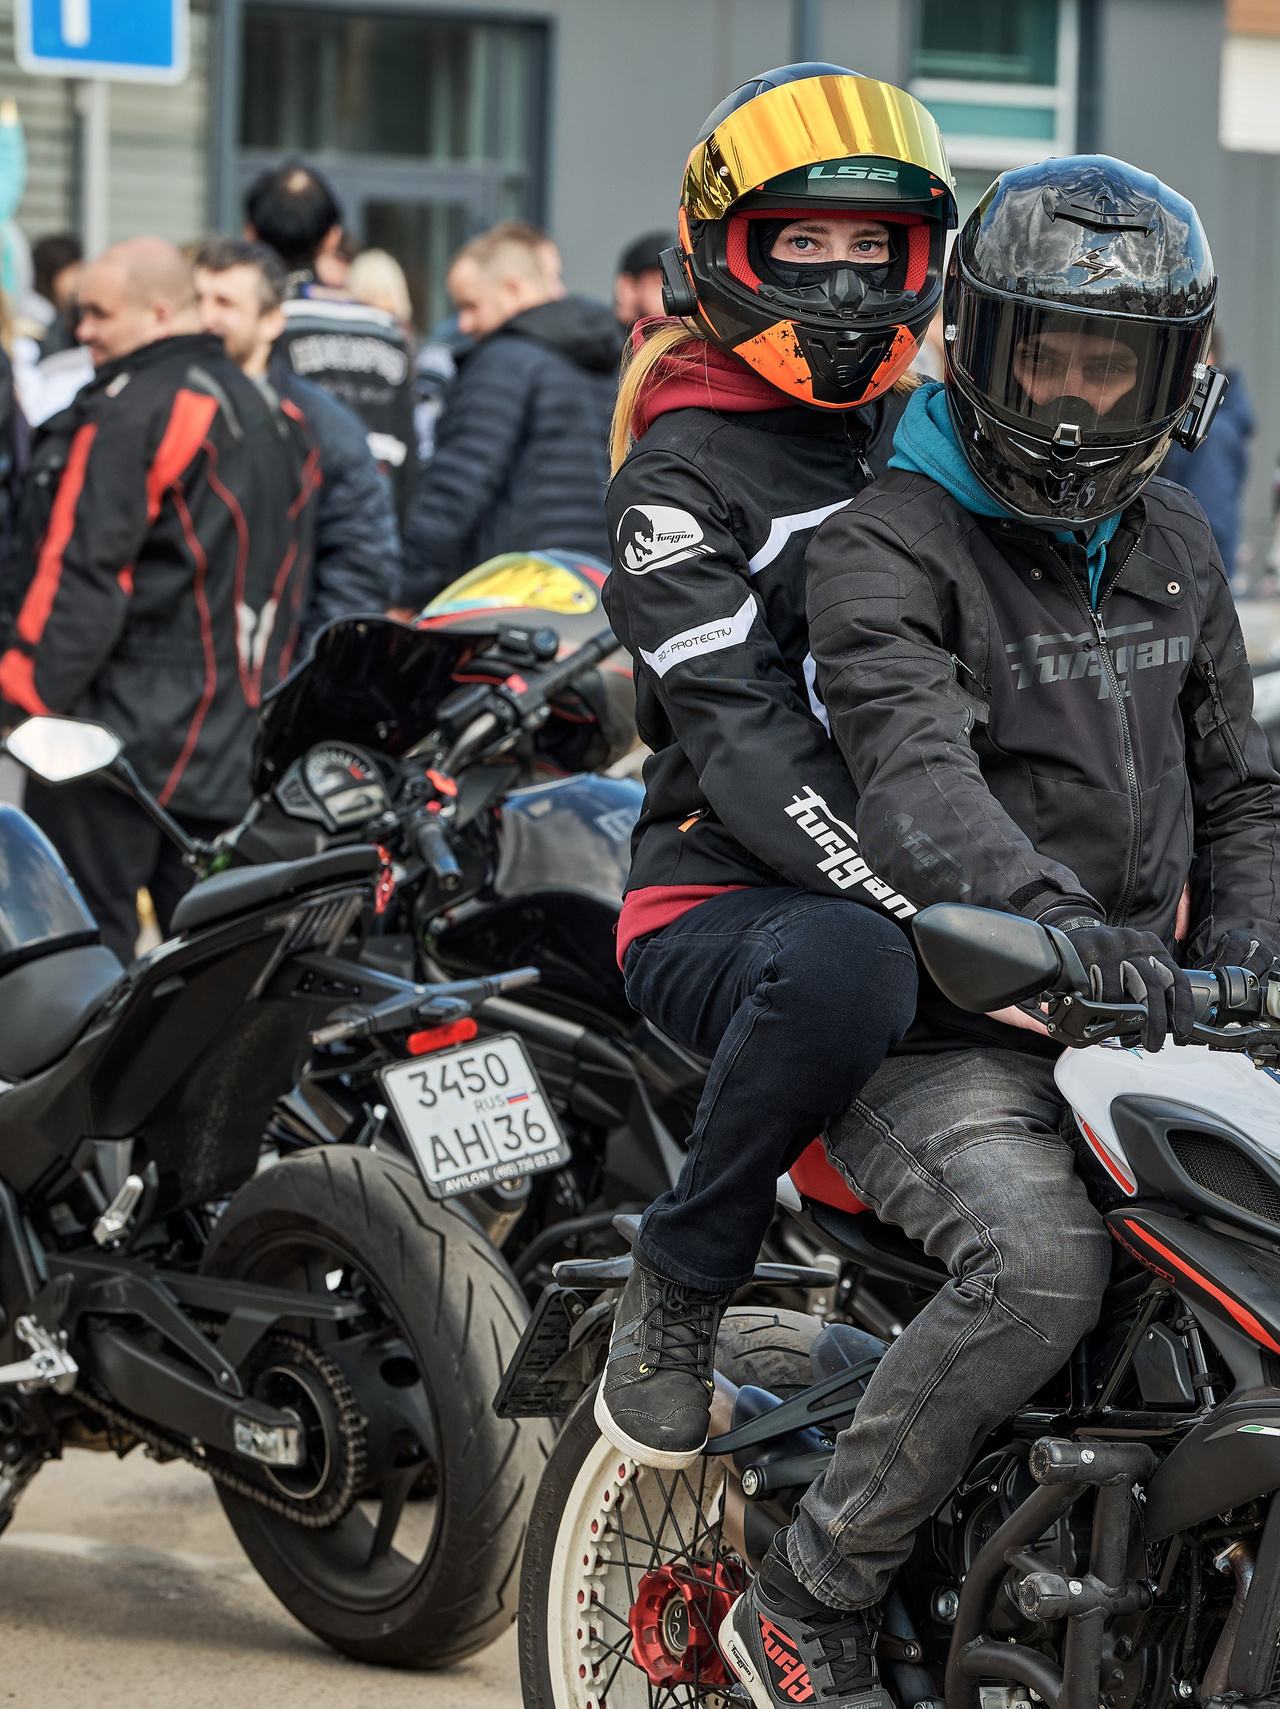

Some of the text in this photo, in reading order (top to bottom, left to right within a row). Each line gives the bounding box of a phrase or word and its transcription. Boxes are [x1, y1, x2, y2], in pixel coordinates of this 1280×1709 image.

[807, 165, 899, 184] LS2
[407, 1053, 510, 1108] 3450
[473, 1094, 507, 1114] RUS
[493, 1108, 547, 1151] 36
[445, 1168, 491, 1194] AVILON
